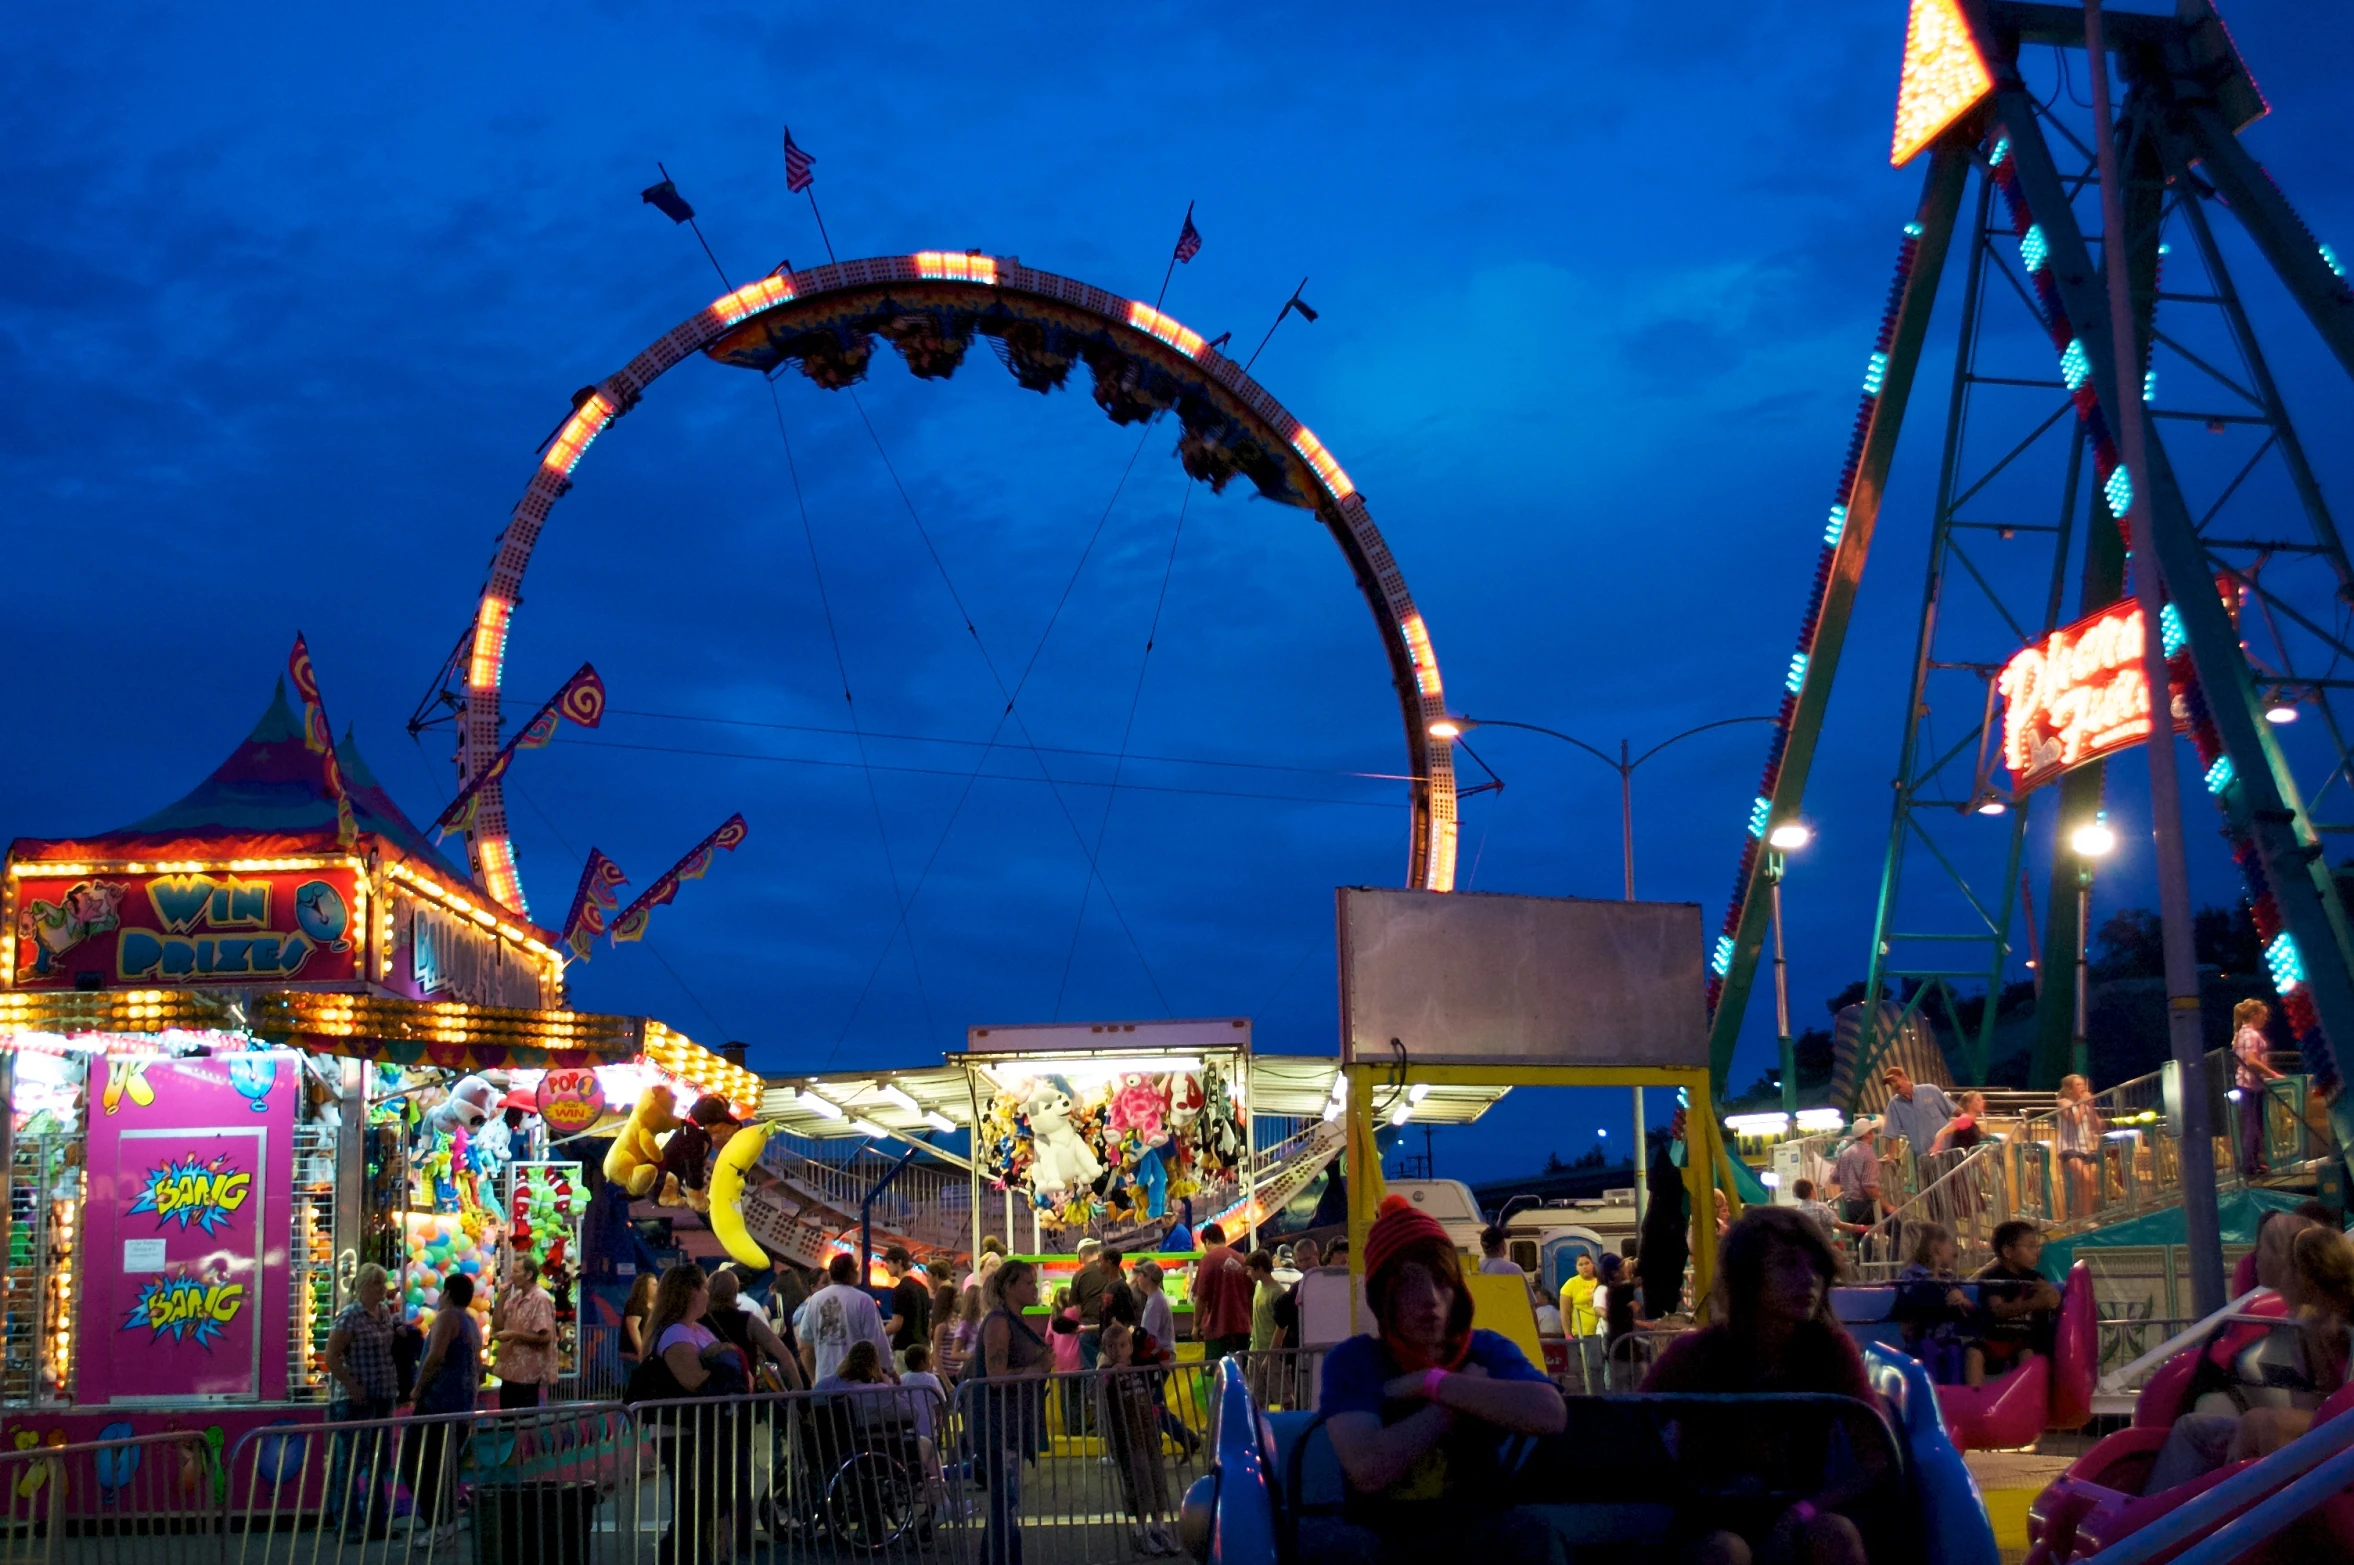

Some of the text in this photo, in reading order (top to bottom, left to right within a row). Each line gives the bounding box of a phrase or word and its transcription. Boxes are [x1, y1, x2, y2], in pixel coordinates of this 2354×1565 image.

[146, 874, 272, 934] WIN
[117, 927, 316, 983] PRIZES
[548, 1072, 579, 1094] POP
[555, 1109, 585, 1118] WIN
[155, 1172, 251, 1216] BANG
[148, 1284, 244, 1330] BANG
